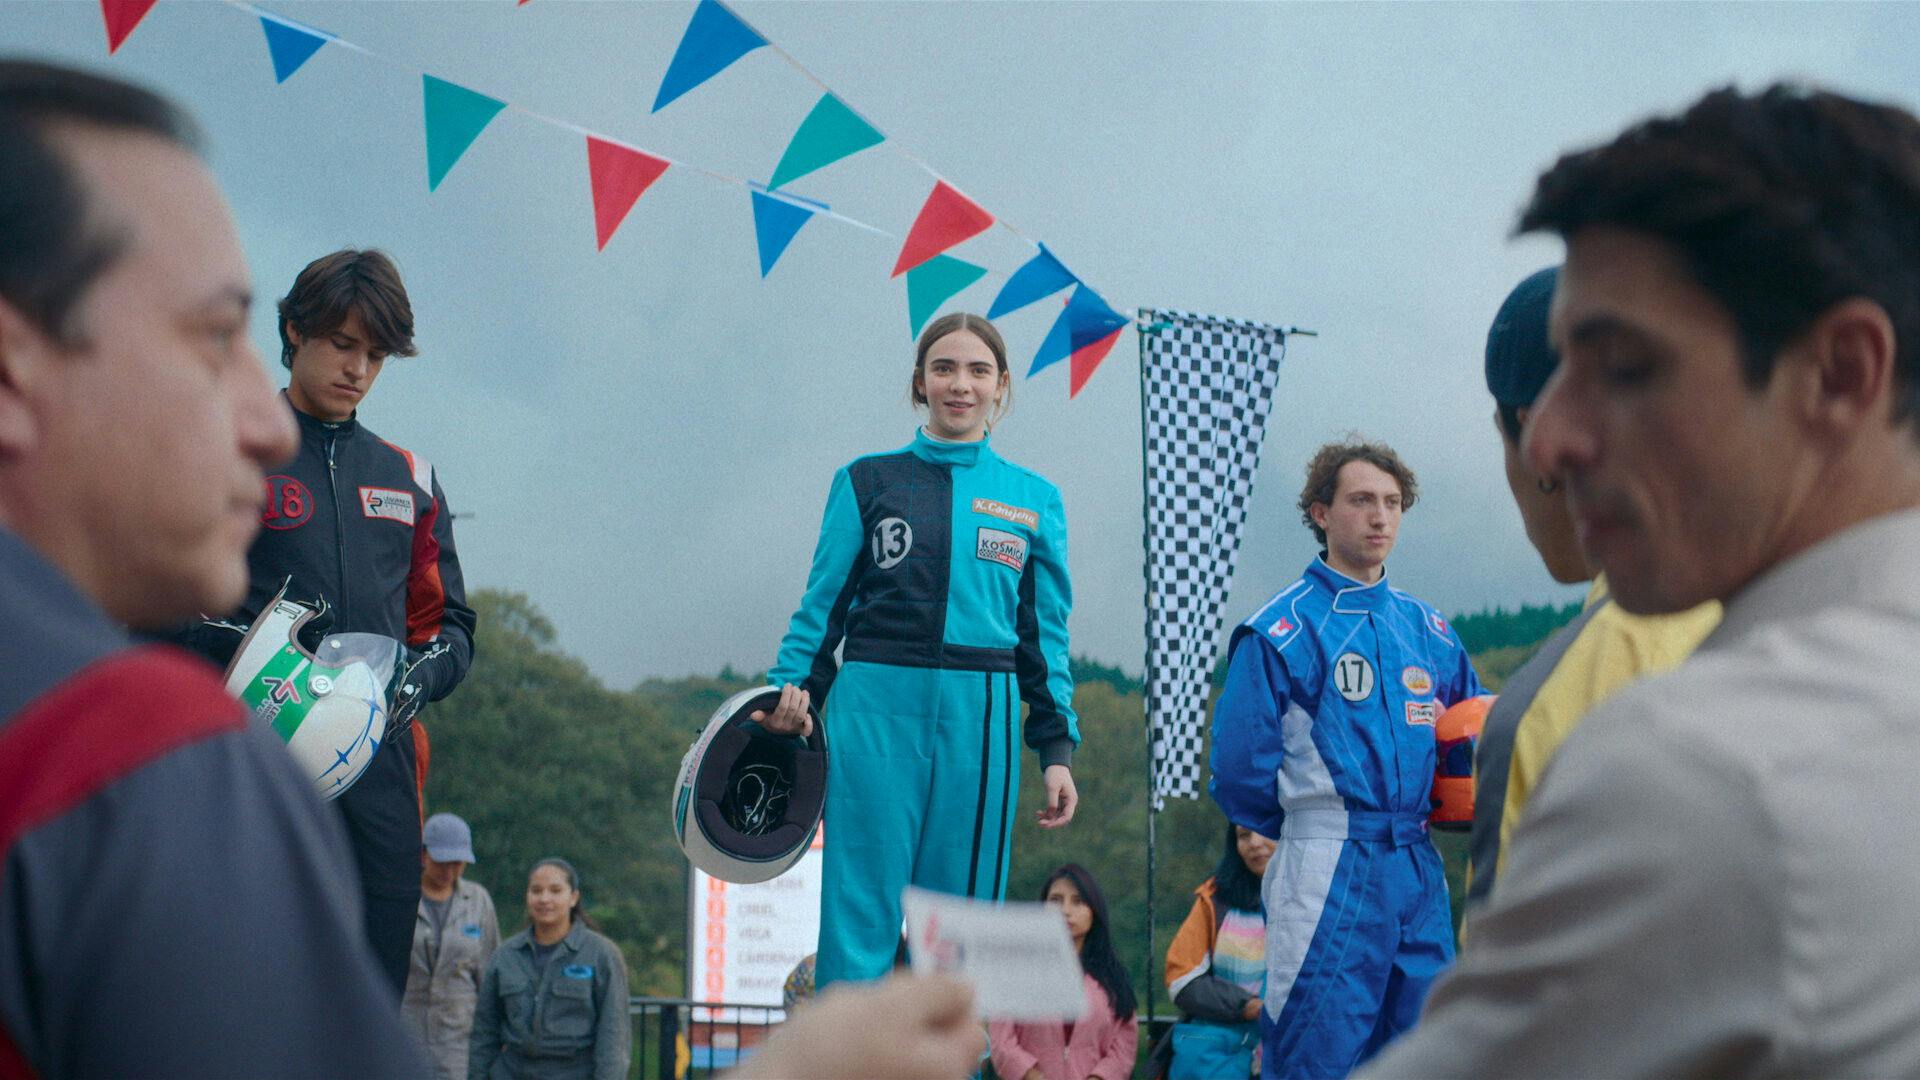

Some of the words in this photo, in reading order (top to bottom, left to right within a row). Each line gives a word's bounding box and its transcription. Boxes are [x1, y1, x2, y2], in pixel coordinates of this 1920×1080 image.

[260, 483, 304, 519] 18
[875, 522, 907, 564] 13
[1340, 660, 1364, 693] 17
